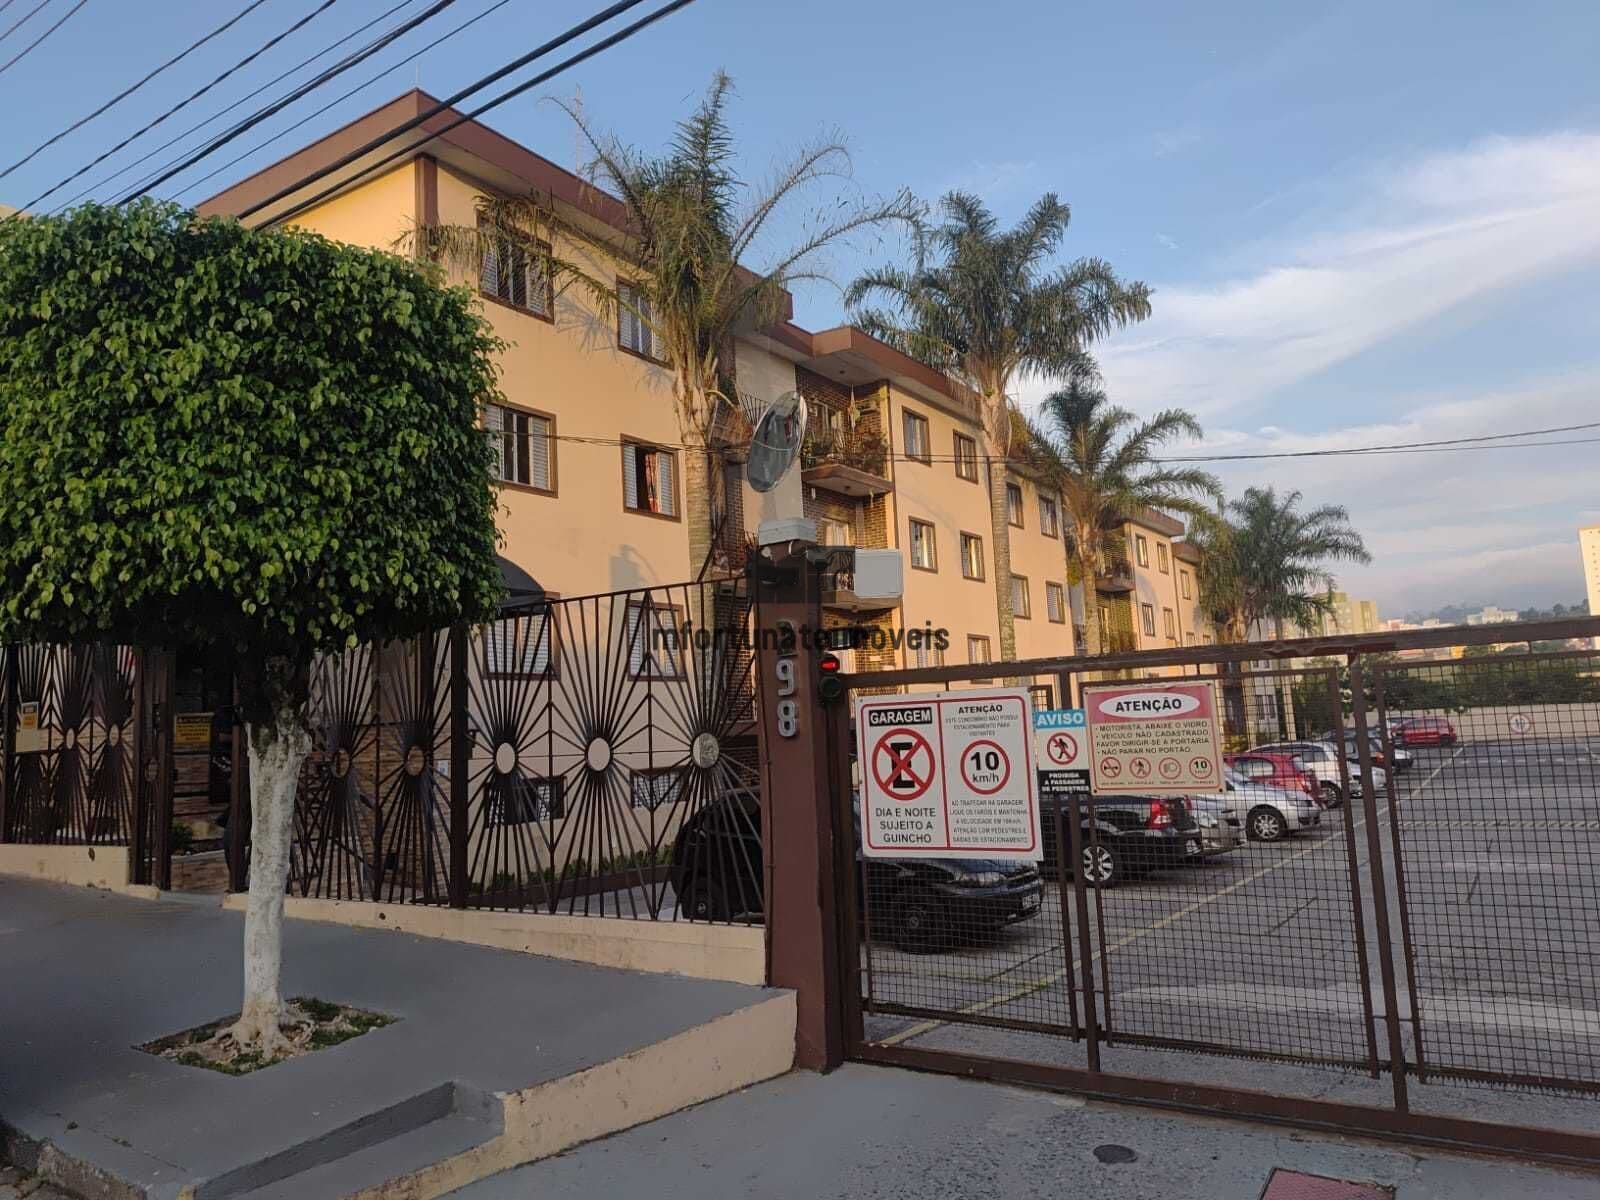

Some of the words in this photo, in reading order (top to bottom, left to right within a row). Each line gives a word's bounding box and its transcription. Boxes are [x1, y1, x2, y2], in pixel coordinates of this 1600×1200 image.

[1115, 696, 1182, 712] ATENÇÃO
[870, 710, 931, 725] GARAGEM
[1037, 712, 1084, 726] AVISO
[1171, 737, 1210, 745] PORTARIA
[970, 752, 1000, 771] 10
[1194, 761, 1208, 770] 10
[972, 772, 1000, 784] km/h
[875, 808, 893, 818] DIA
[895, 808, 901, 817] E
[905, 807, 936, 818] NOITE
[880, 820, 924, 831] SUJEITO
[926, 820, 934, 830] A
[883, 832, 932, 844] GUINCHO
